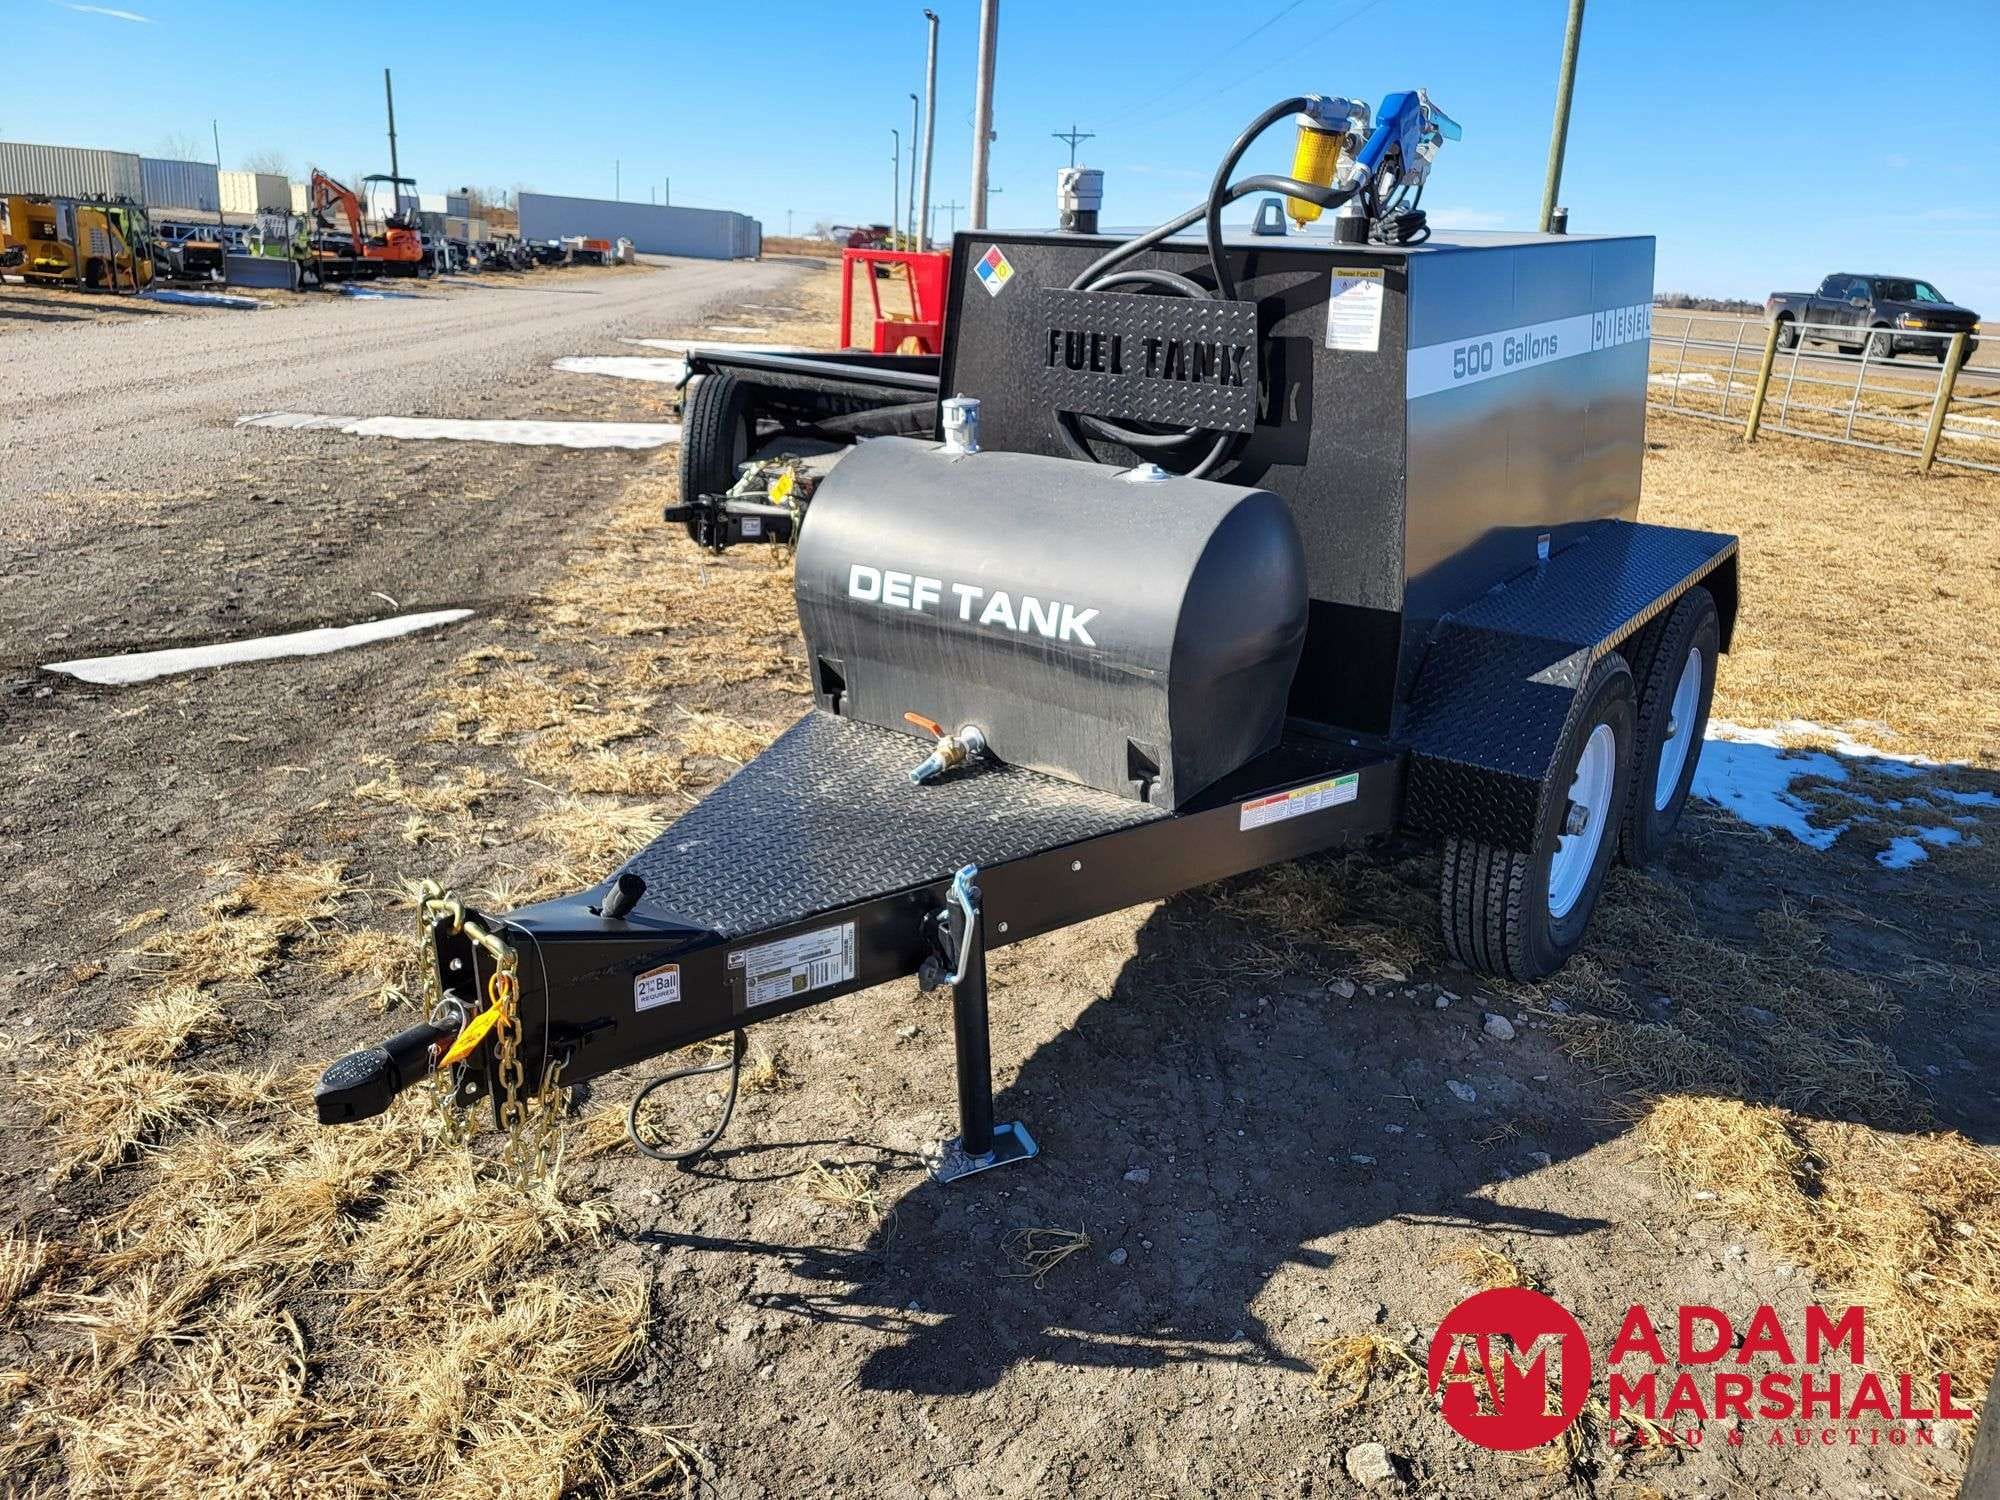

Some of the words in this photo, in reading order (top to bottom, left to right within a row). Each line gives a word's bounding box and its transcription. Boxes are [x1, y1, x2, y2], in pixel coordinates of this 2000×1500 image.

[1596, 310, 1650, 342] DIESEL
[1046, 328, 1123, 376] FUEL
[1142, 336, 1247, 388] TANK
[1453, 341, 1493, 380] 500
[1502, 332, 1559, 367] Gallons
[848, 563, 943, 612] DEF
[951, 581, 1101, 647] TANK
[656, 974, 676, 990] Ball
